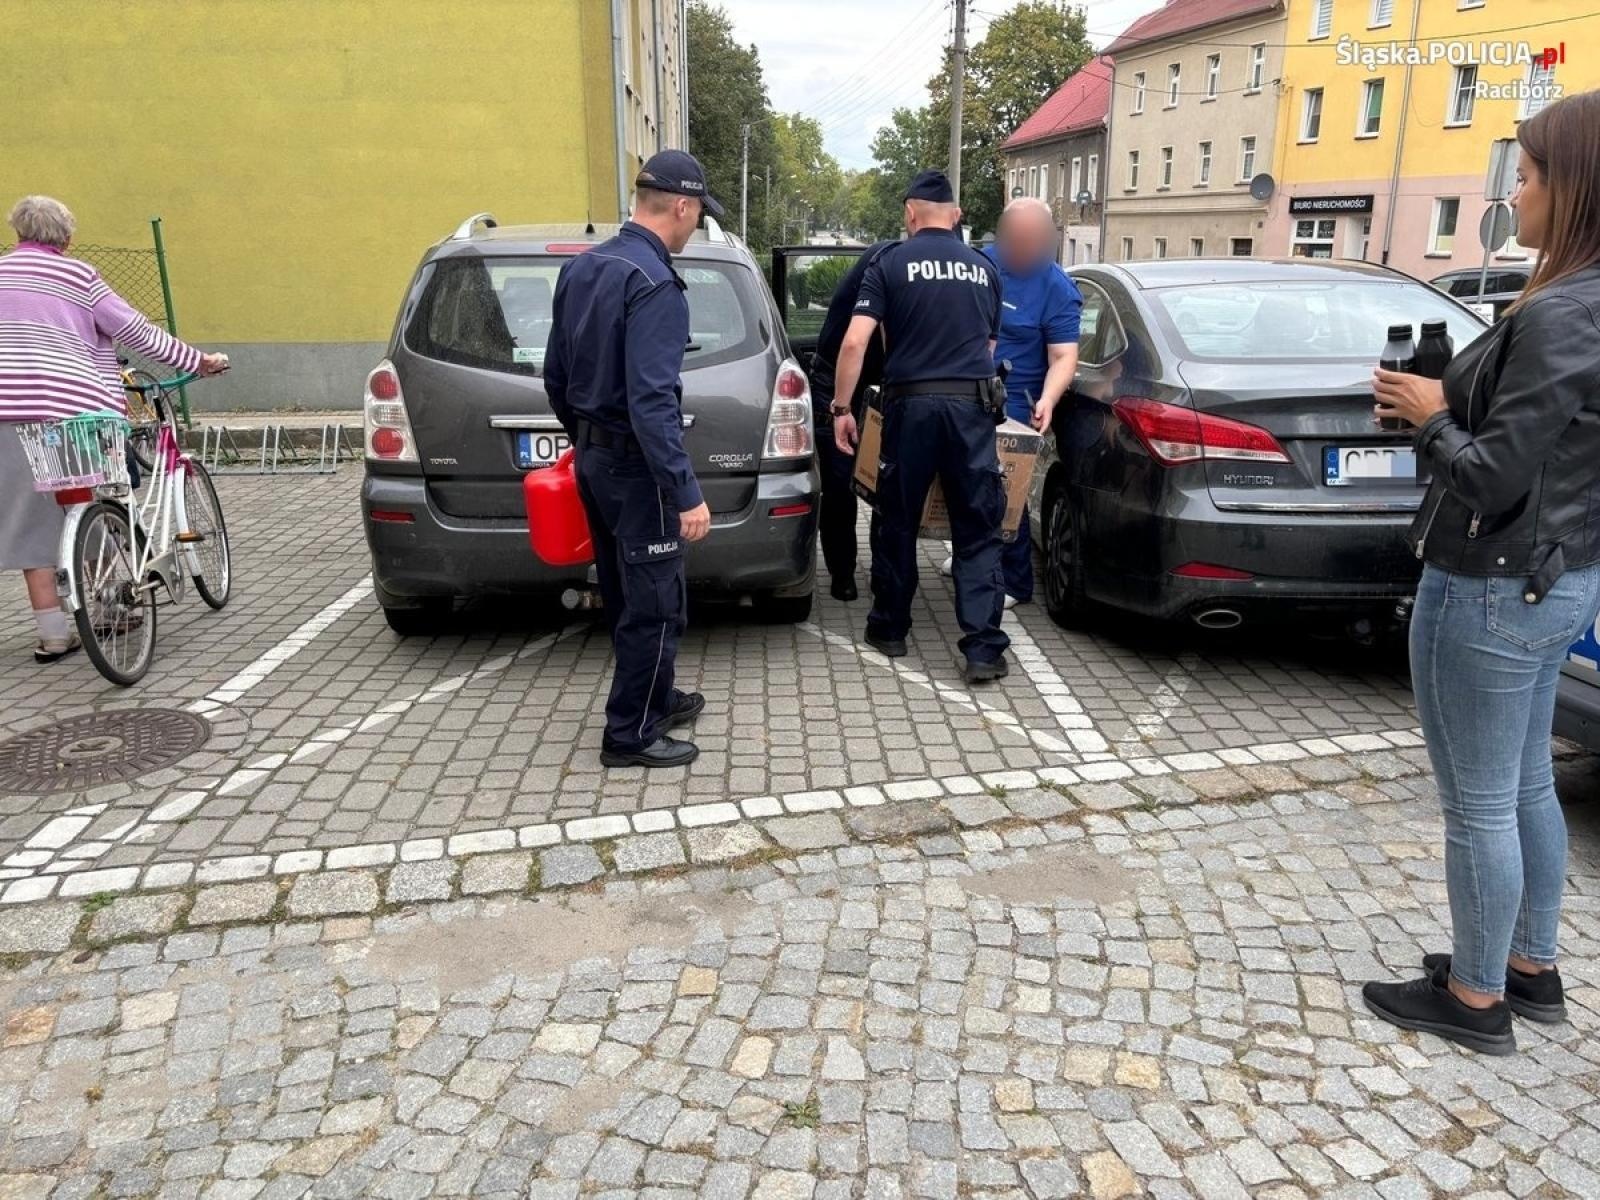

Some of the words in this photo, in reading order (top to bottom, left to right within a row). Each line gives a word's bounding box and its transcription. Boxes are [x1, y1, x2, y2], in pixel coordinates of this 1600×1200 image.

[1293, 201, 1313, 209] BIURO
[1313, 198, 1366, 208] NIERUCHOMOŚCI
[907, 260, 989, 287] POLICJA
[709, 453, 753, 462] COROLLA
[1327, 467, 1338, 475] PL
[1223, 474, 1274, 485] HYUNDAI
